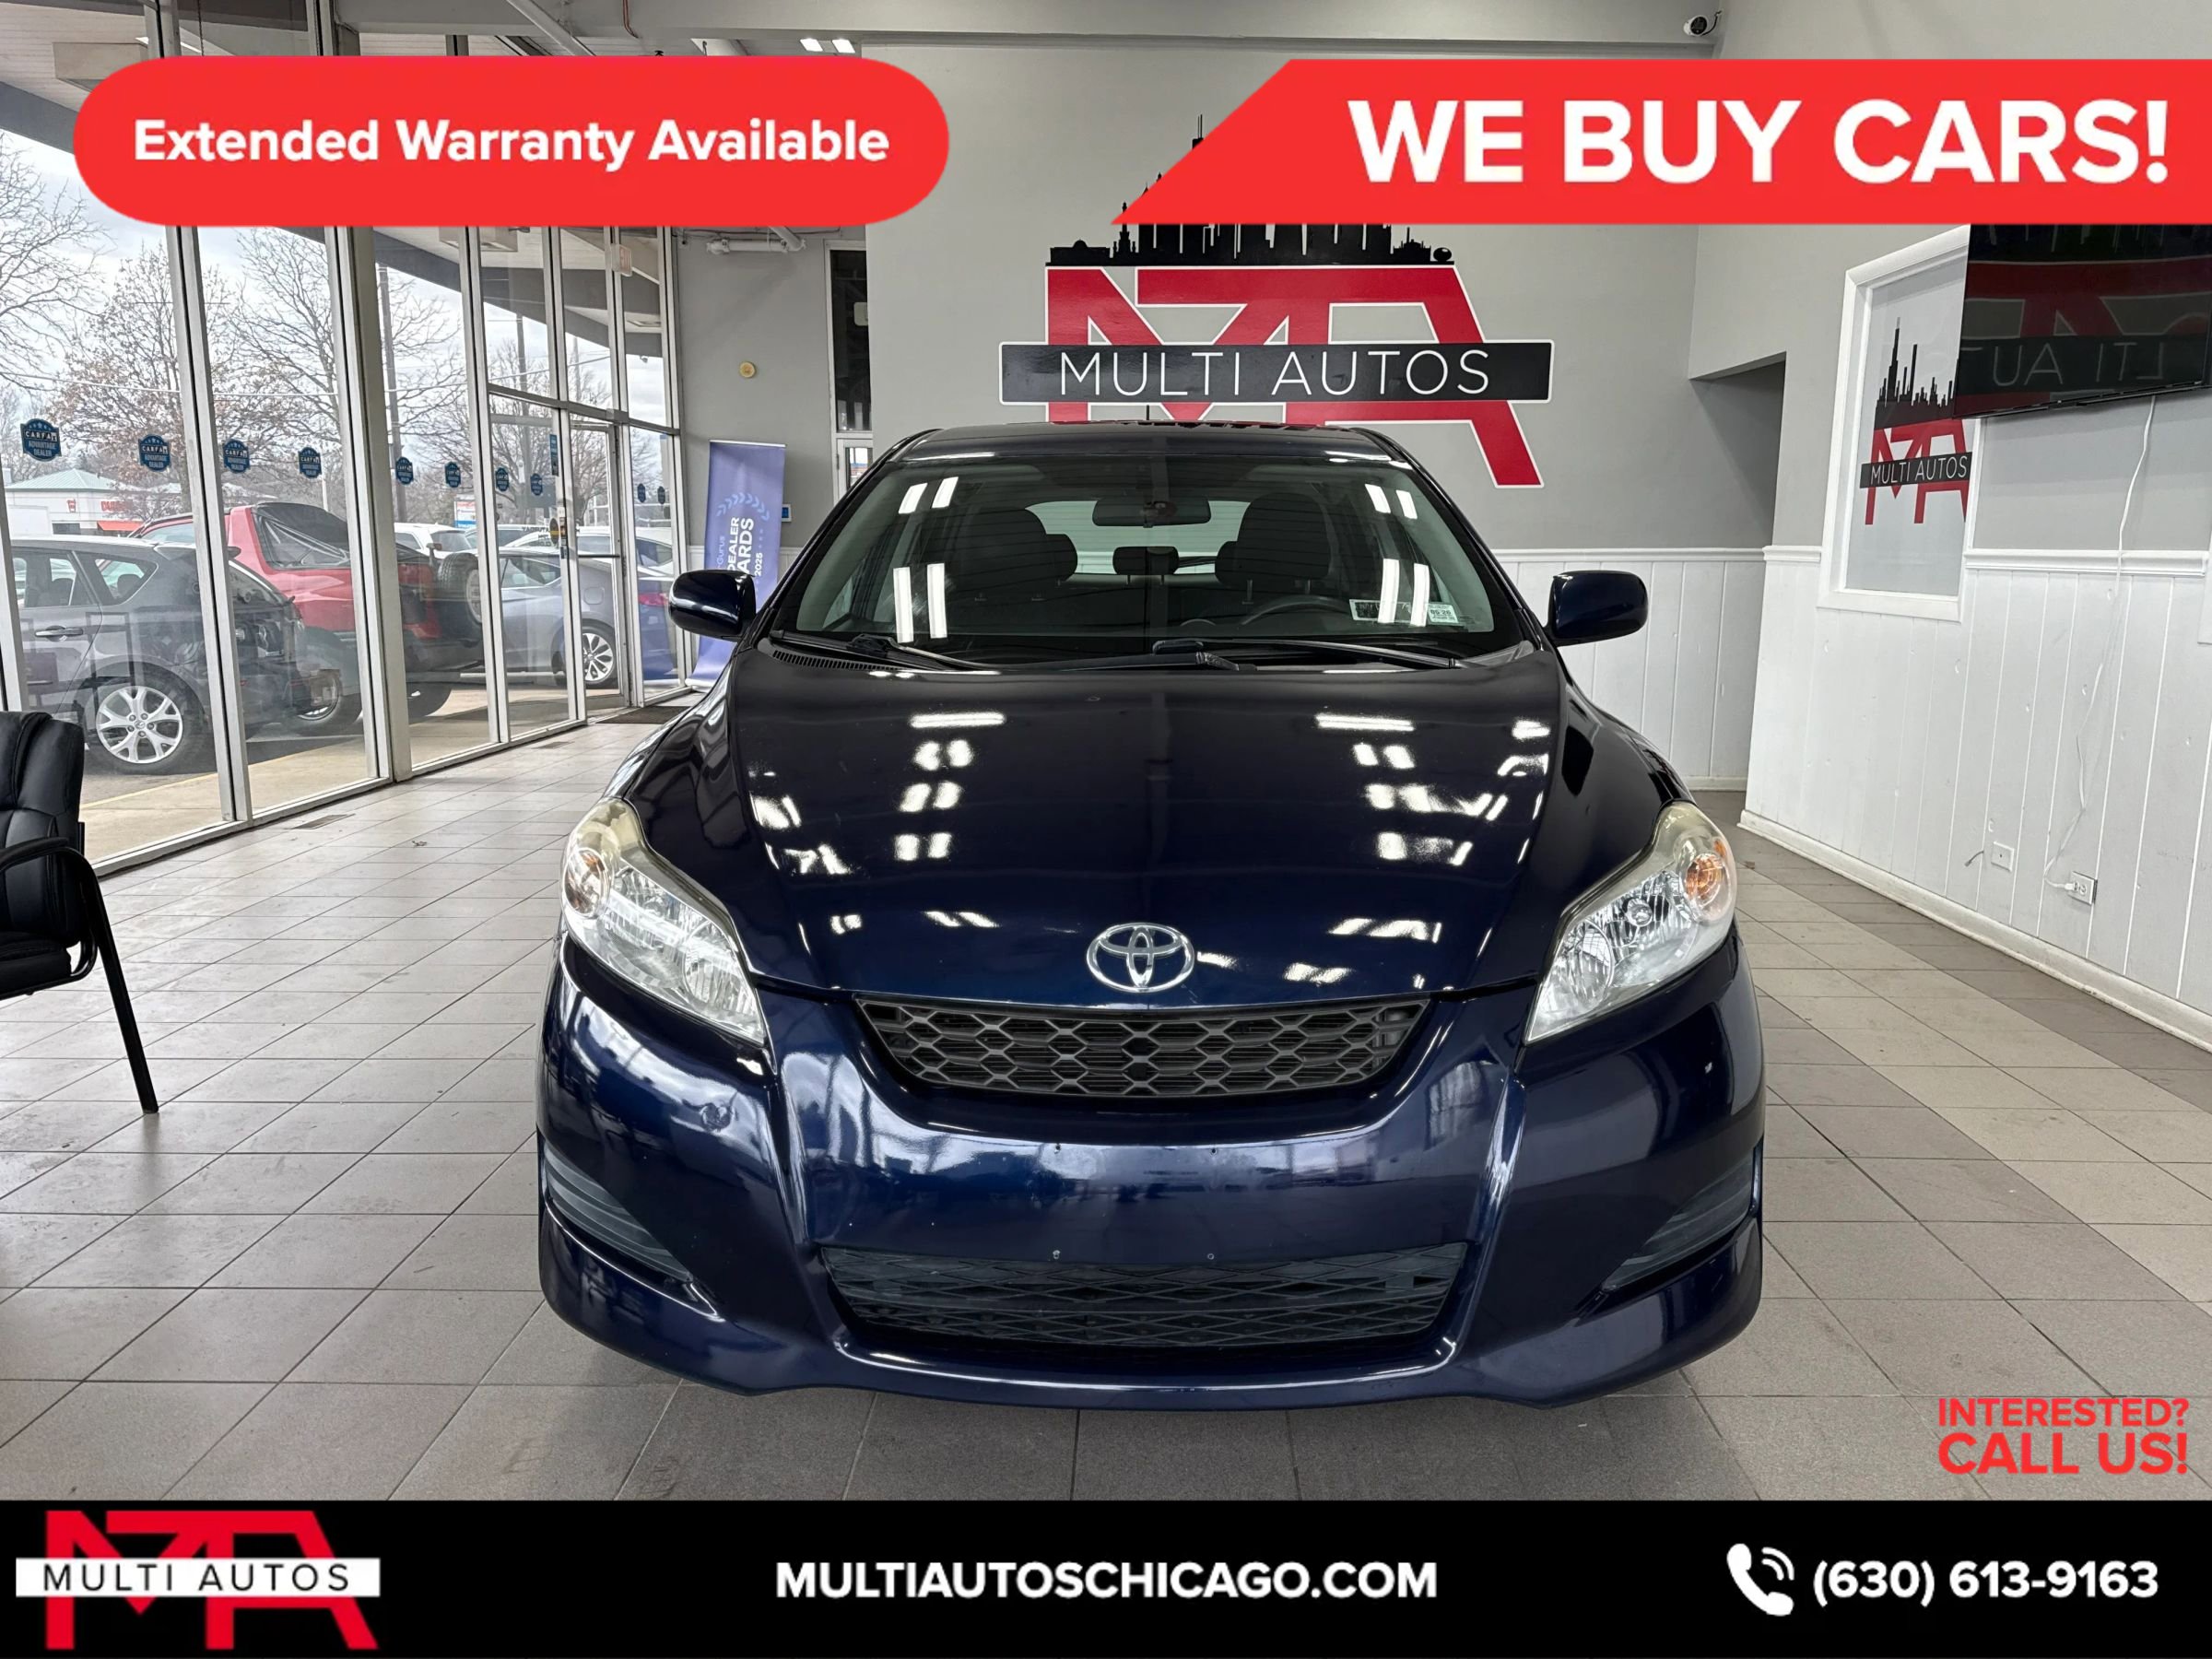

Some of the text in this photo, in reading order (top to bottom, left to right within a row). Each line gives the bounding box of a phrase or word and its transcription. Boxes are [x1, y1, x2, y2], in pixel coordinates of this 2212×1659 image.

[1060, 349, 1489, 396] MULTI AUTOS
[1870, 455, 1968, 485] MULTI AUTOS
[716, 535, 726, 569] Gurus
[726, 516, 740, 571] DEALER
[736, 517, 754, 574] ARDS
[754, 552, 764, 577] 2025
